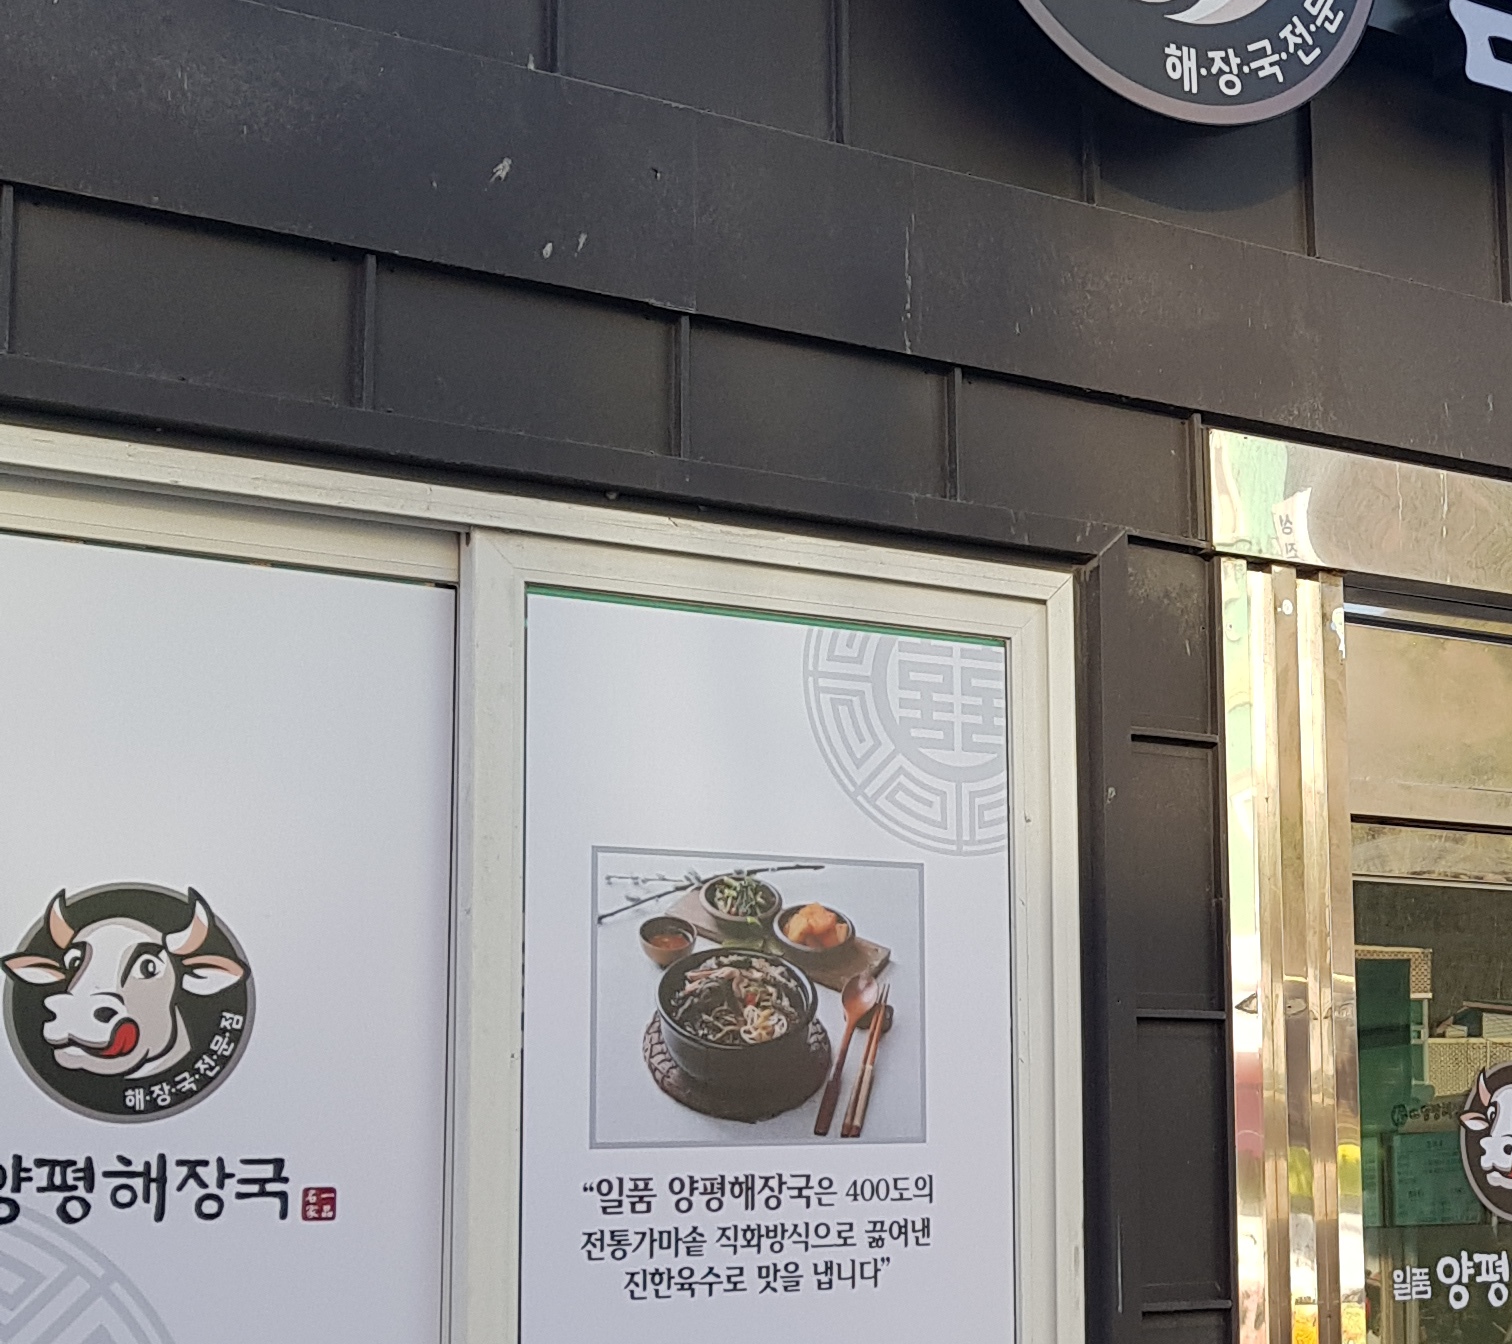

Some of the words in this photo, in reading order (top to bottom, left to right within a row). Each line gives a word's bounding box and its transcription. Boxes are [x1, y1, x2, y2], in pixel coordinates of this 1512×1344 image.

[668, 1172, 838, 1214] 양평해장국은
[845, 1174, 933, 1204] 400도의
[580, 1225, 707, 1261] 전통가마솥
[715, 1221, 857, 1256] 직화방식으로
[864, 1217, 931, 1249] 끓여낸
[623, 1266, 747, 1301] 진한육수로
[757, 1261, 804, 1294] 맛을
[1393, 1265, 1432, 1301] 일품
